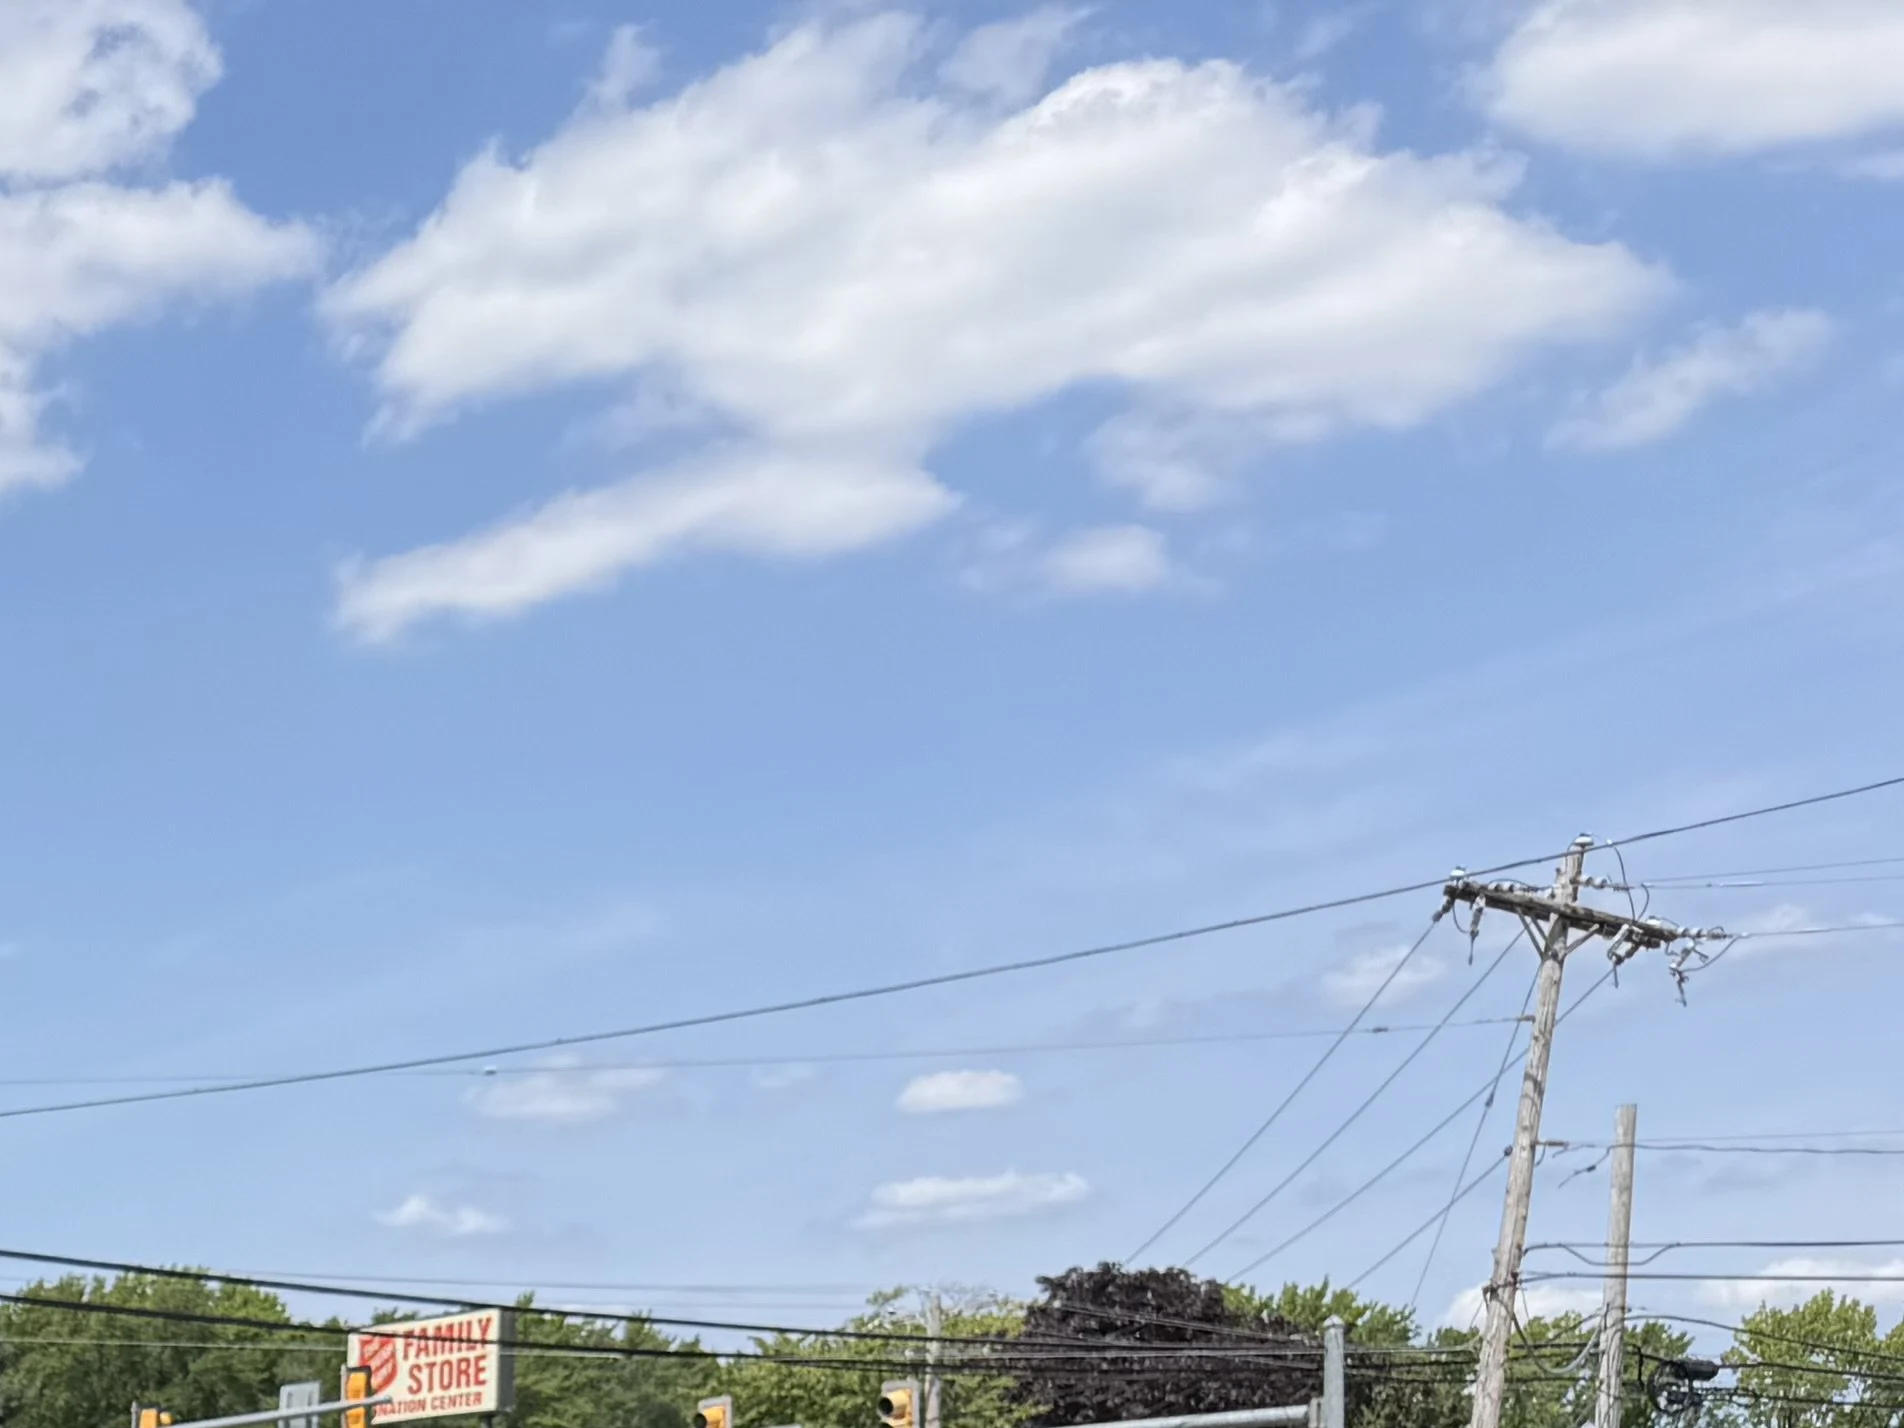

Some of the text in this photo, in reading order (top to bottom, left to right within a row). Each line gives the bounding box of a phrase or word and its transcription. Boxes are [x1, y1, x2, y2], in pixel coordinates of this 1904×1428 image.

[403, 1317, 492, 1360] FAMILY
[408, 1355, 487, 1395] STORE
[373, 1392, 483, 1417] NATION CENTER
